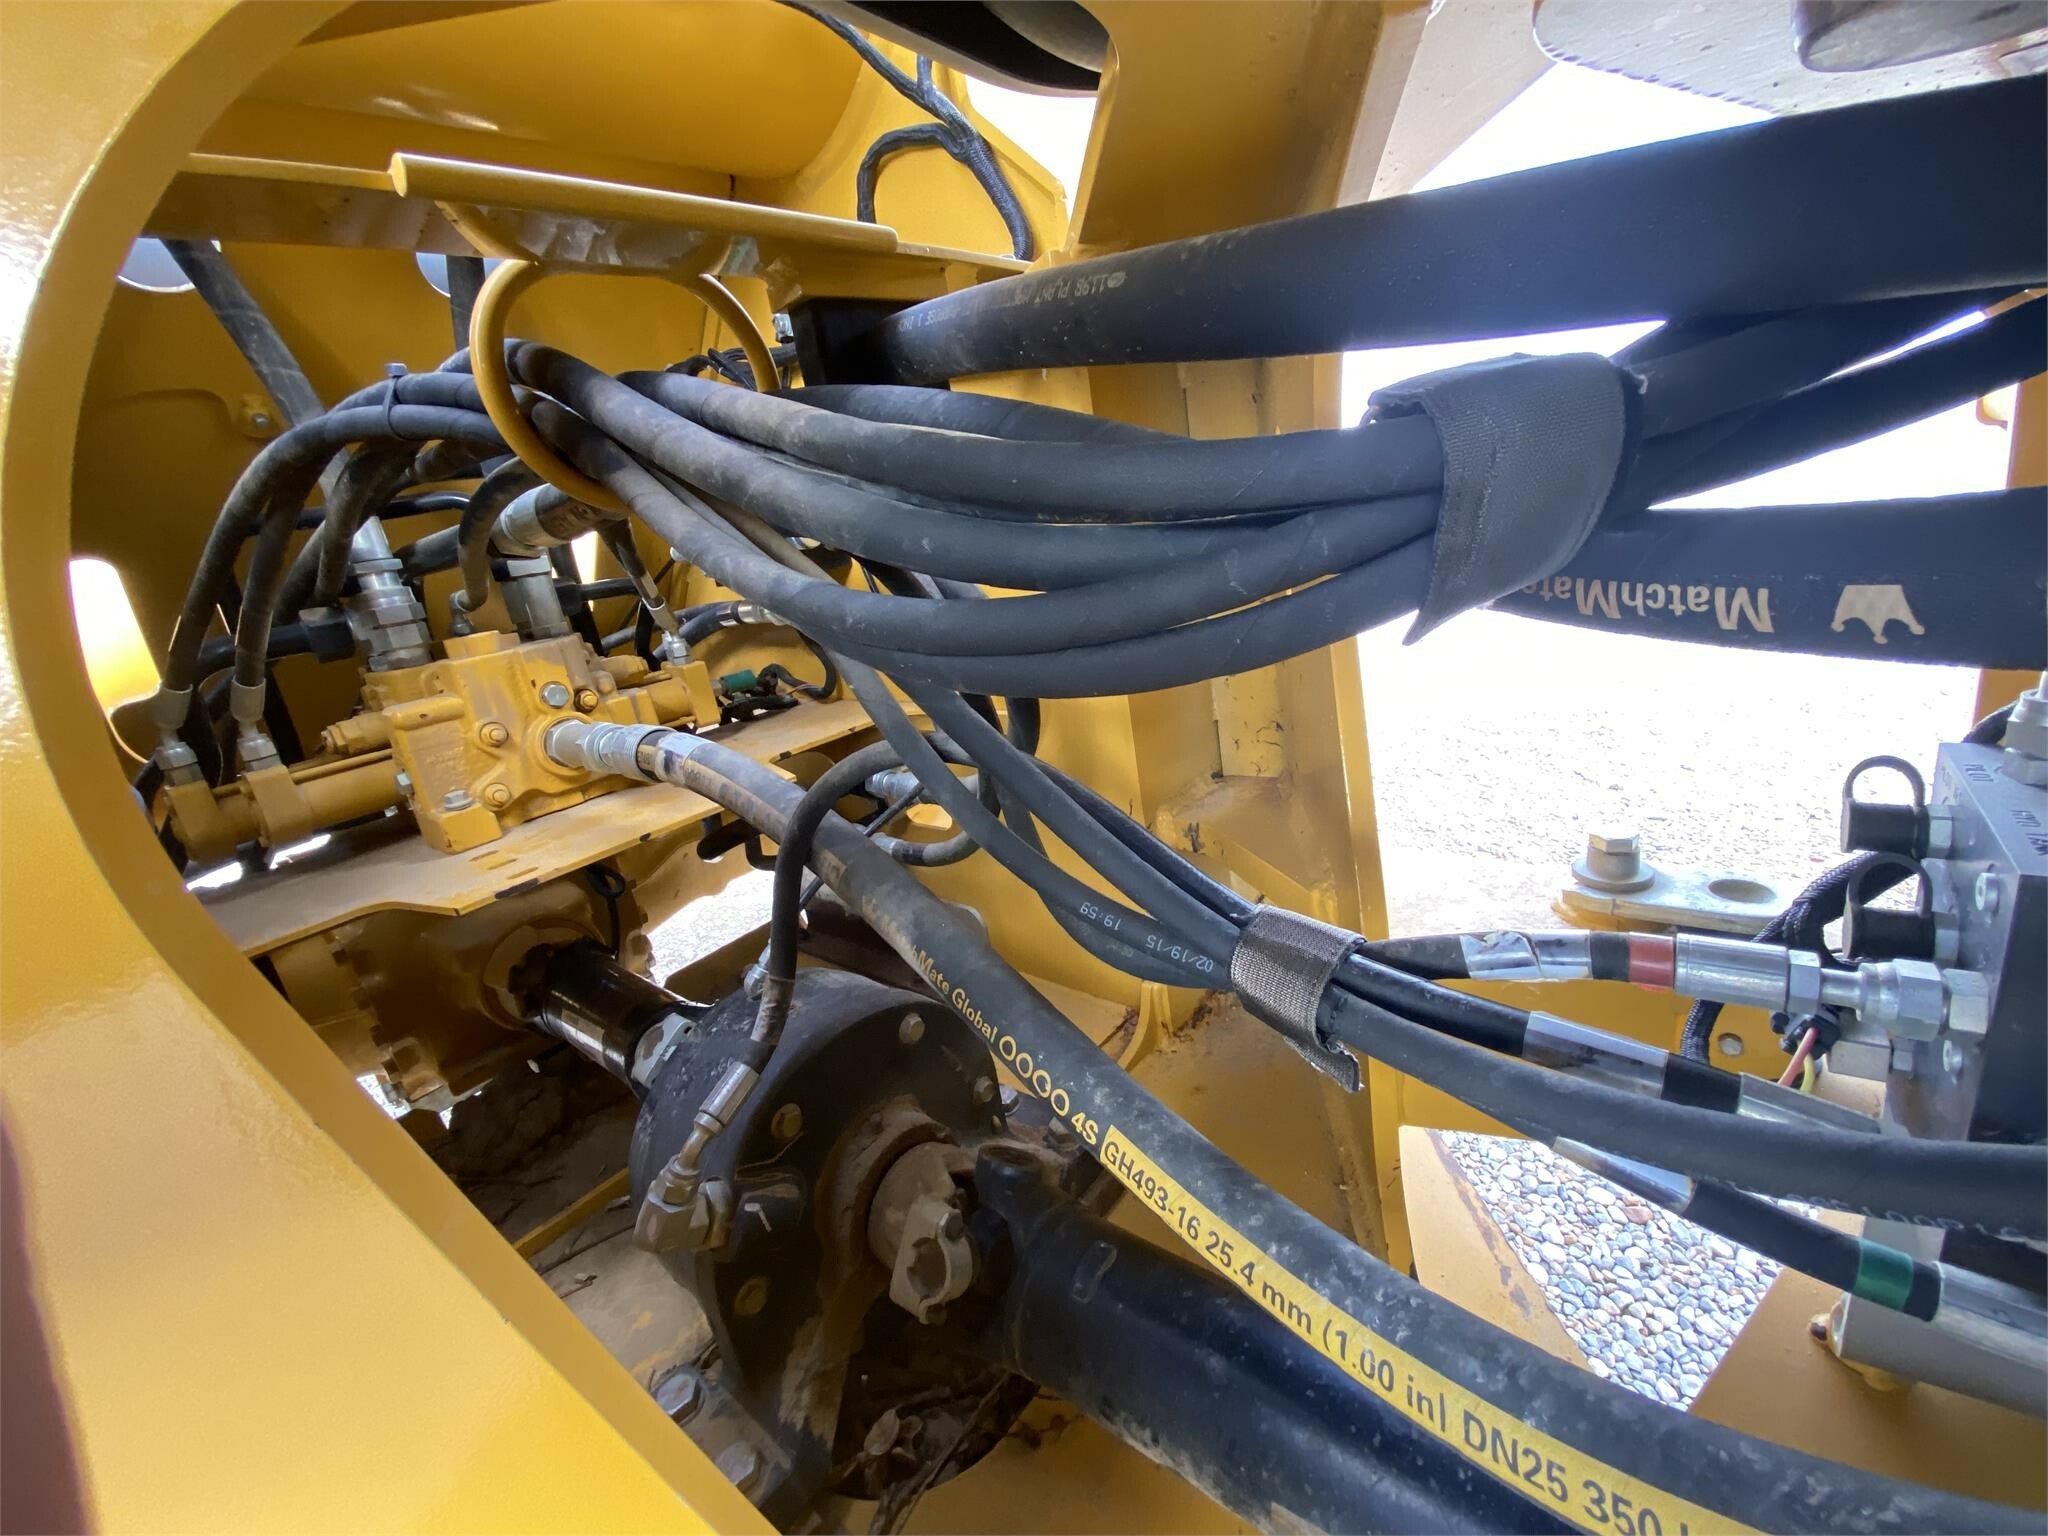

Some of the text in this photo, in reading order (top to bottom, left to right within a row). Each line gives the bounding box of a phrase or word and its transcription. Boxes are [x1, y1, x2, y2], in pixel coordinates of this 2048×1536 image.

[1080, 902, 1121, 931] 19:59
[1145, 935, 1214, 973] 02/19/15
[952, 988, 998, 1043] Global
[1071, 1112, 1099, 1145] 4S
[1104, 1141, 1200, 1241] GH493-16
[1205, 1230, 1256, 1287] 25.4
[1262, 1281, 1312, 1336] mm
[1322, 1319, 1395, 1393] (1.00
[1463, 1408, 1569, 1503] DN25
[1582, 1469, 1663, 1536] 350
